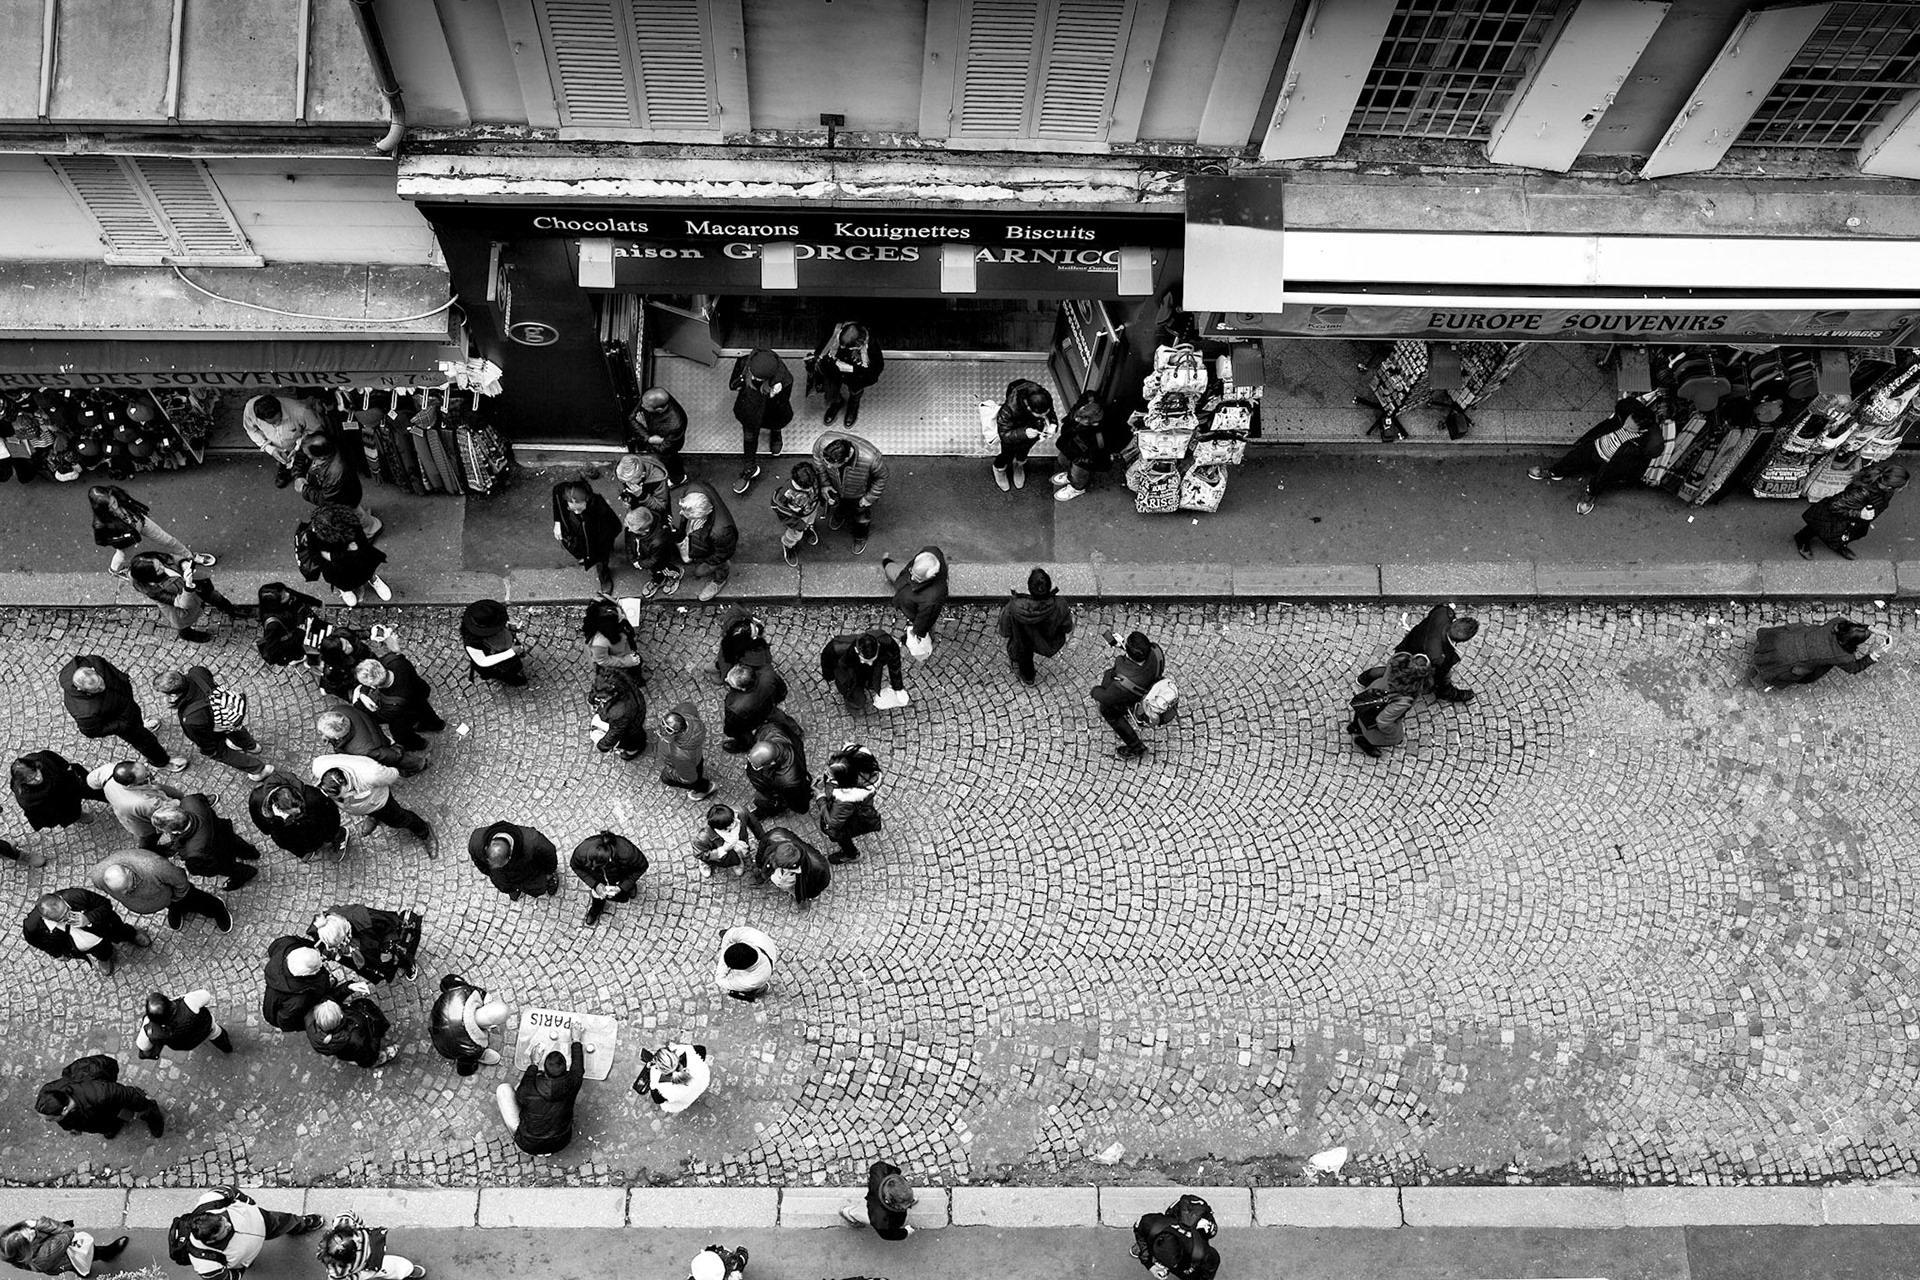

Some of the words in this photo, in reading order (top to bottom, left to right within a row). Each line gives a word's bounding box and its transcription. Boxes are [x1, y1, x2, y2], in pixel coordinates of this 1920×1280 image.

[533, 216, 649, 233] Chocolats
[685, 220, 799, 236] Macarons
[834, 222, 970, 240] Kouignettes
[1005, 226, 1096, 240] Biscuits
[575, 242, 704, 259] aison
[723, 242, 920, 261] GORGES
[1427, 312, 1543, 329] EUROPE
[1561, 313, 1728, 331] SOUVENIRS
[80, 373, 143, 385] DES
[153, 371, 352, 385] SOUVENIRS
[404, 374, 418, 385] 7
[1765, 482, 1797, 493] PARIS
[1137, 491, 1168, 508] PARIS
[530, 1012, 572, 1030] PARIS
